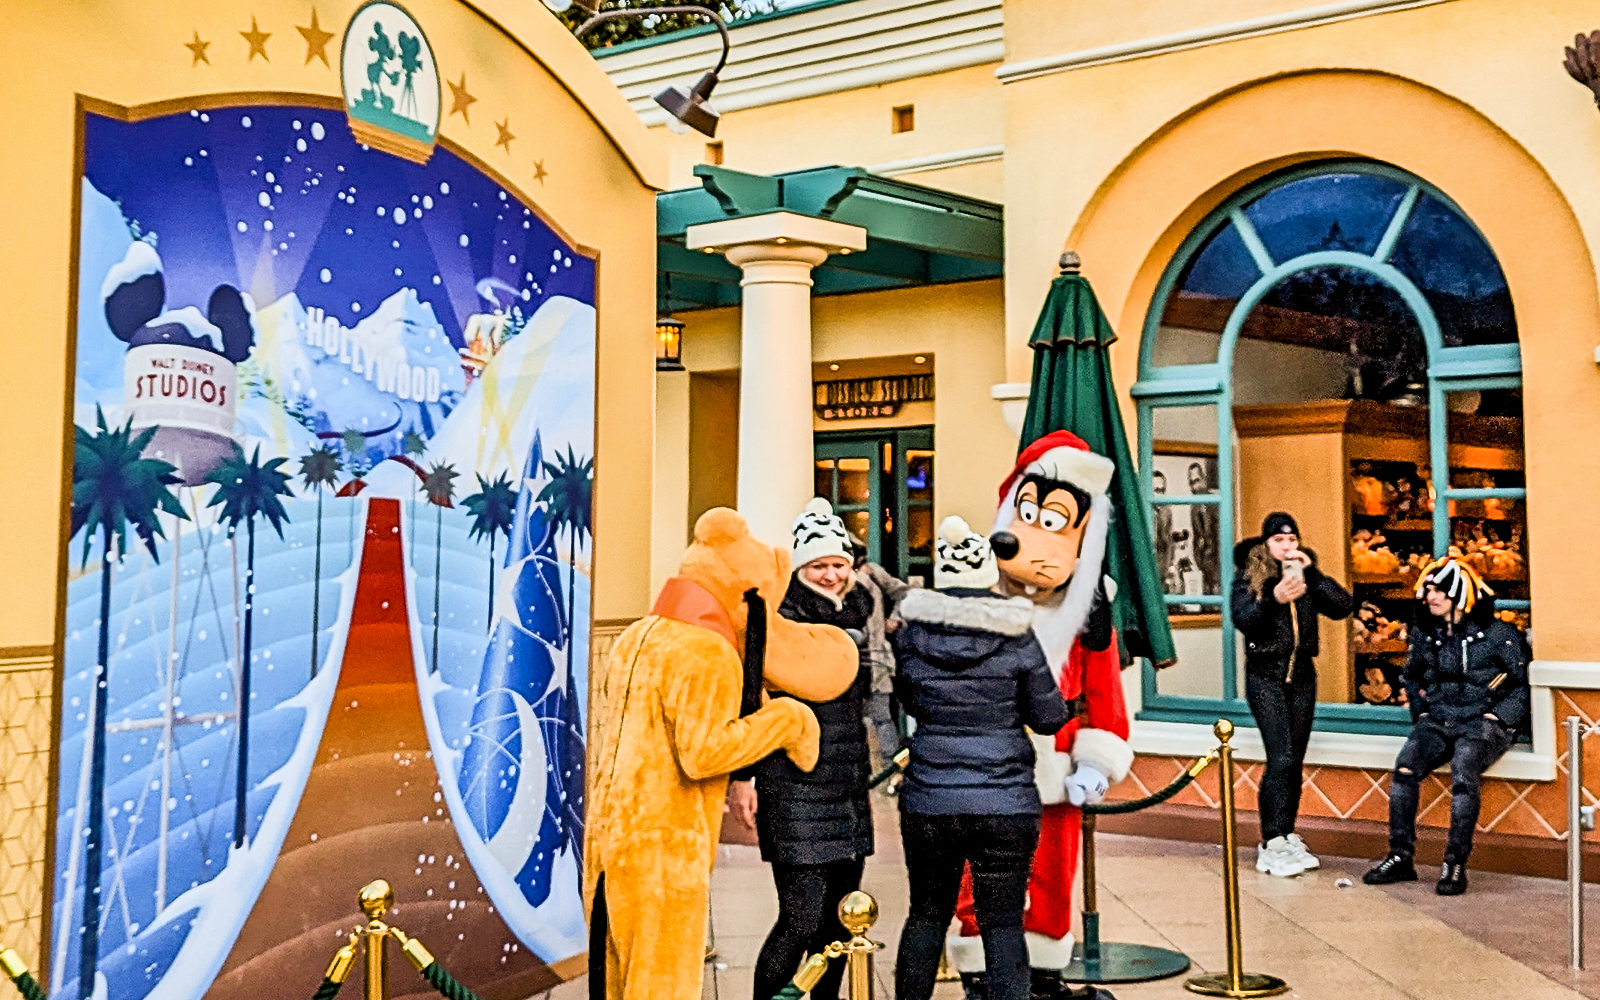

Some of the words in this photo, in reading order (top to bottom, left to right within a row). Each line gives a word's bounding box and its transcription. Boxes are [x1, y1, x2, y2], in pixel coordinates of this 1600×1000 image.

[150, 357, 175, 369] WALT
[306, 306, 440, 403] HOLLYWOOD
[135, 373, 227, 407] STUDIOS
